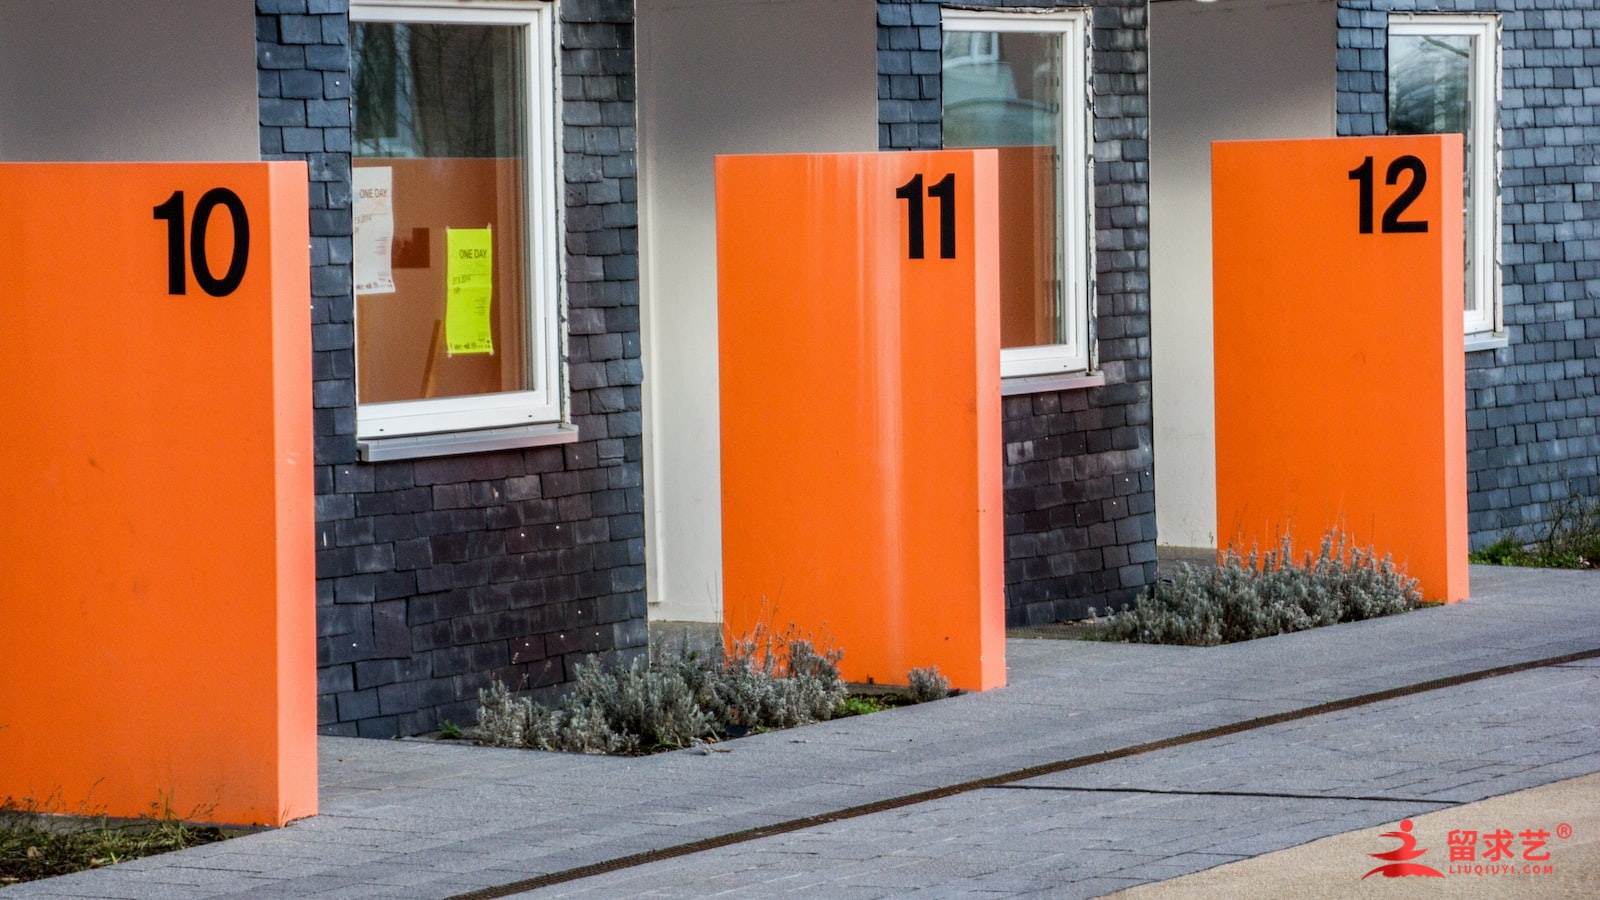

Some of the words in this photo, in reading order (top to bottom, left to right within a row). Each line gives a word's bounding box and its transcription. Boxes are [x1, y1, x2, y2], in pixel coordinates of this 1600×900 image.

[359, 188, 373, 199] ONE
[374, 188, 388, 198] DAY
[896, 173, 956, 260] 11
[1348, 155, 1429, 235] 12
[153, 187, 250, 298] 10
[458, 248, 473, 259] ONE
[474, 248, 487, 259] DAY
